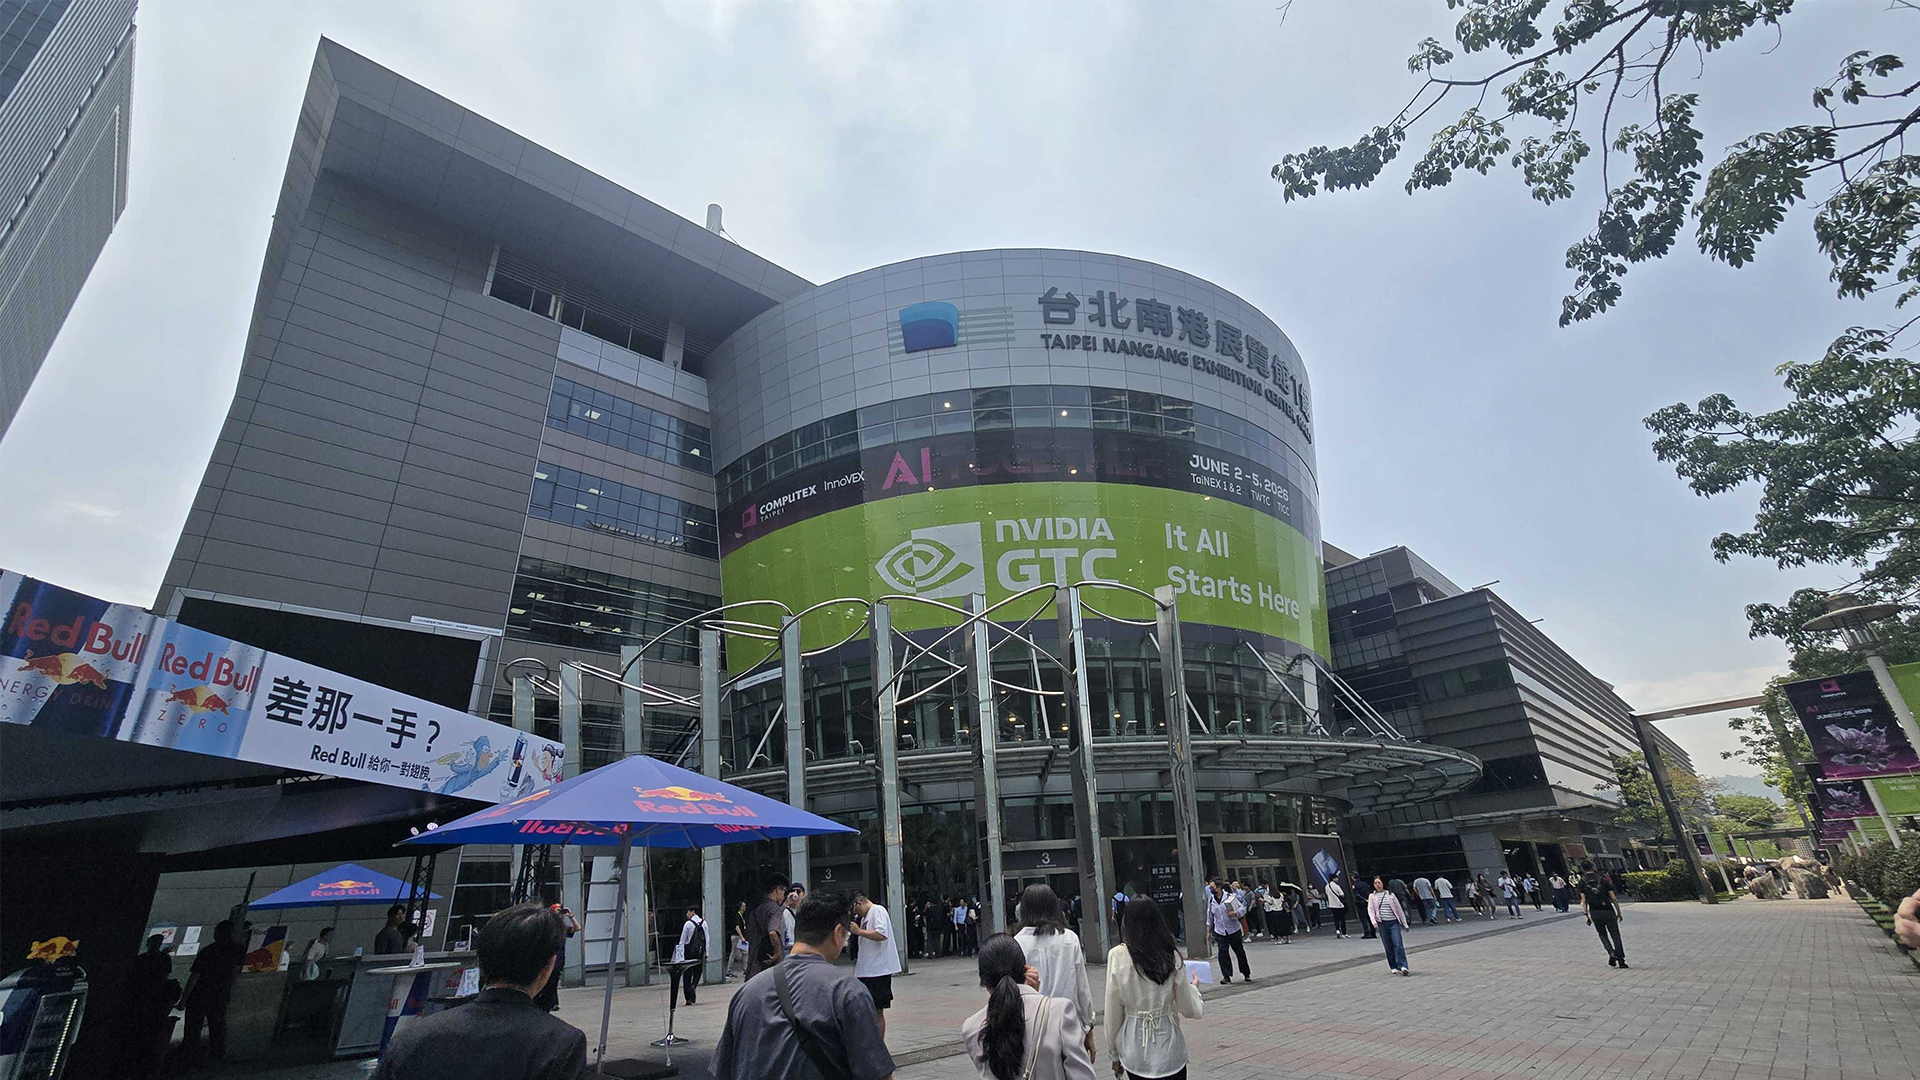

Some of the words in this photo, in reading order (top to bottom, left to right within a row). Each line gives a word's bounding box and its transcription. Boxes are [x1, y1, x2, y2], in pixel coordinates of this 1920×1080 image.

[1041, 334, 1097, 351] TAIPEI
[1103, 337, 1189, 366] NANGANG
[1193, 354, 1263, 396] EXHIBITION
[882, 447, 932, 490] AI
[1189, 454, 1230, 476] JUNE
[1264, 479, 1289, 502] 2026
[759, 485, 817, 515] COMPUTEX
[824, 471, 865, 491] InnoVEX
[1190, 473, 1222, 489] TaiNEX
[1223, 481, 1228, 491] 1
[1229, 482, 1235, 493] &
[1236, 485, 1242, 495] 2
[1251, 490, 1271, 506] TWTC
[760, 508, 785, 522] TAIPEI
[1165, 522, 1188, 551] It
[1196, 528, 1229, 558] All
[996, 548, 1119, 592] GTC
[1167, 566, 1253, 605] Starts
[1258, 581, 1300, 620] Here
[8, 601, 84, 648] Red
[84, 622, 147, 664] Bull
[158, 642, 213, 682] Red
[212, 656, 261, 694] Bull
[157, 709, 228, 733] ZERO
[310, 745, 339, 763] Red
[341, 748, 367, 769] Bull
[633, 800, 702, 815] Red
[699, 802, 758, 818] Bull
[1041, 851, 1051, 864] 3
[1246, 844, 1255, 856] 3
[825, 868, 832, 880] 3
[348, 888, 381, 896] Bull
